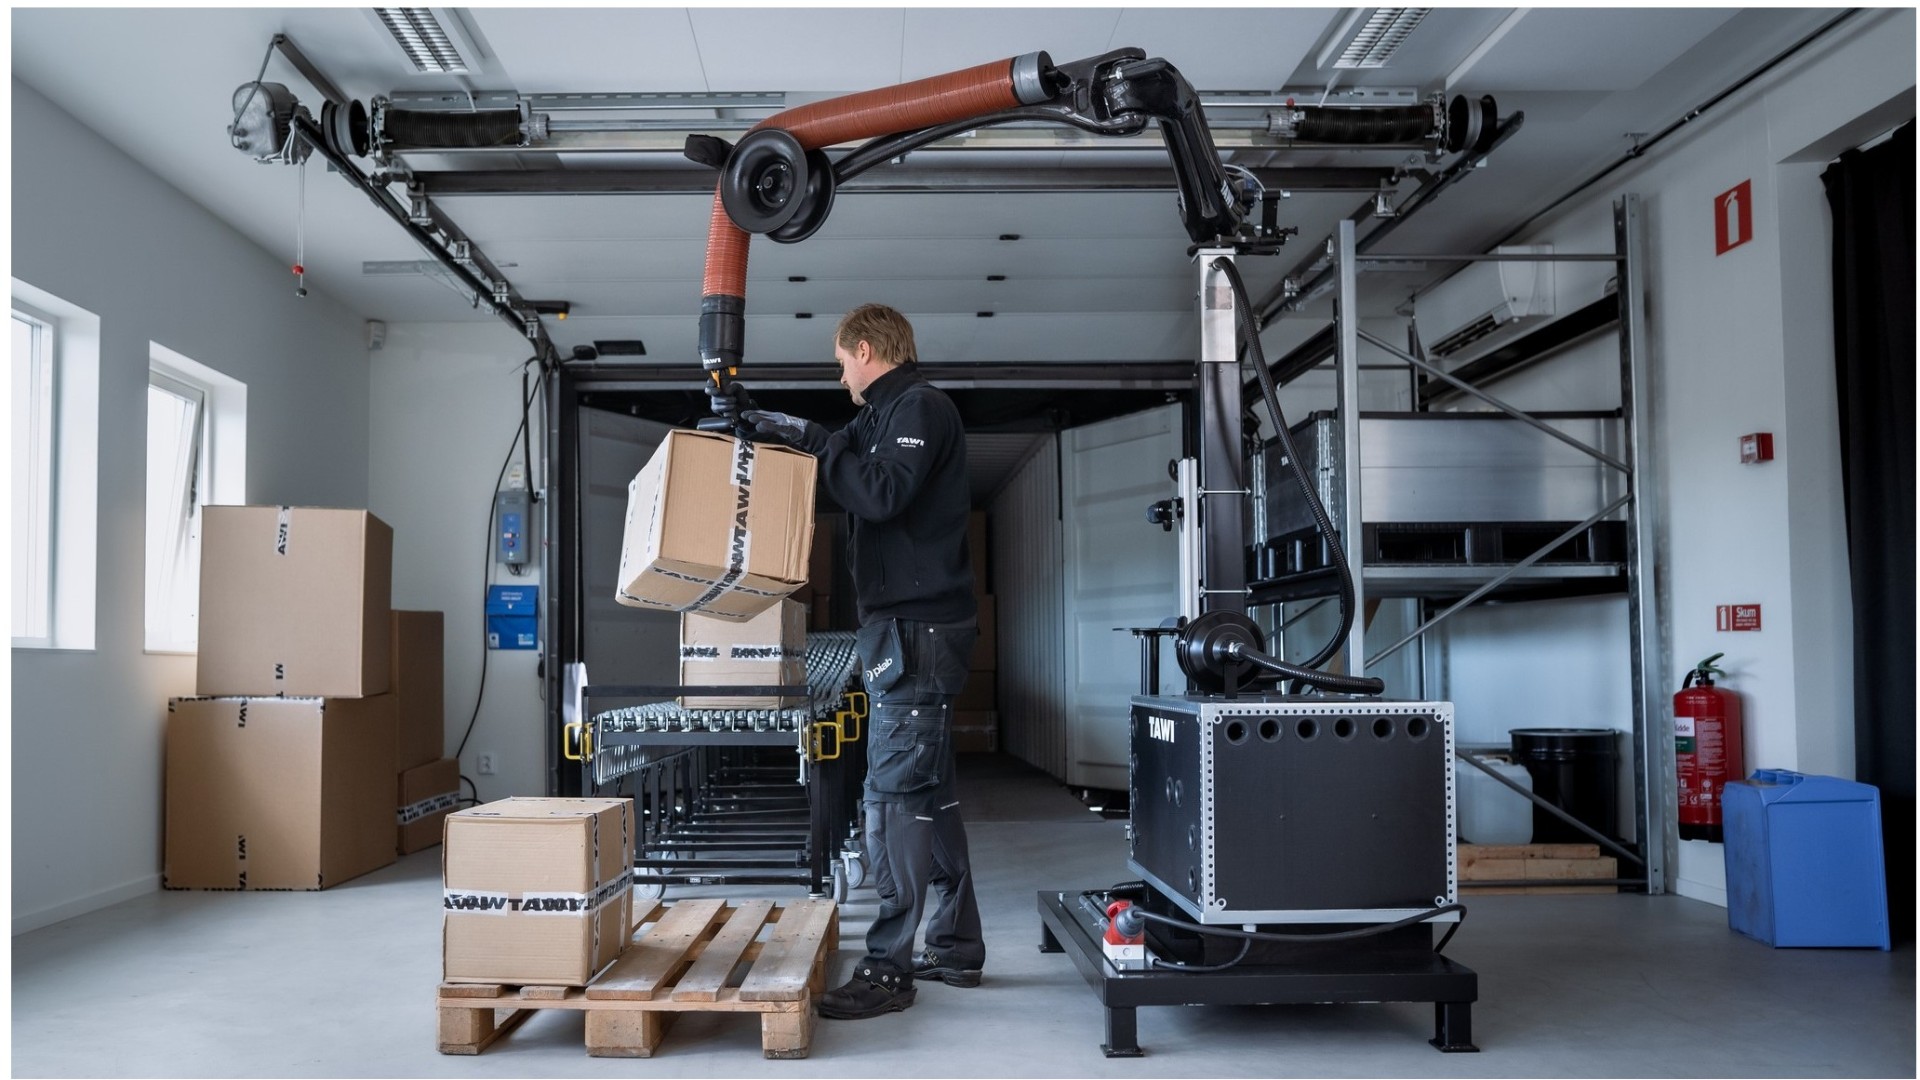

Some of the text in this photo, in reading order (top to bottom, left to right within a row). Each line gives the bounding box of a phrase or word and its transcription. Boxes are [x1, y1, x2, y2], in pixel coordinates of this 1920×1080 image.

[896, 436, 925, 447] TAWI
[653, 566, 716, 586] TAWI
[1736, 606, 1757, 618] Skum
[872, 657, 893, 678] piab
[1148, 715, 1175, 744] TAWI
